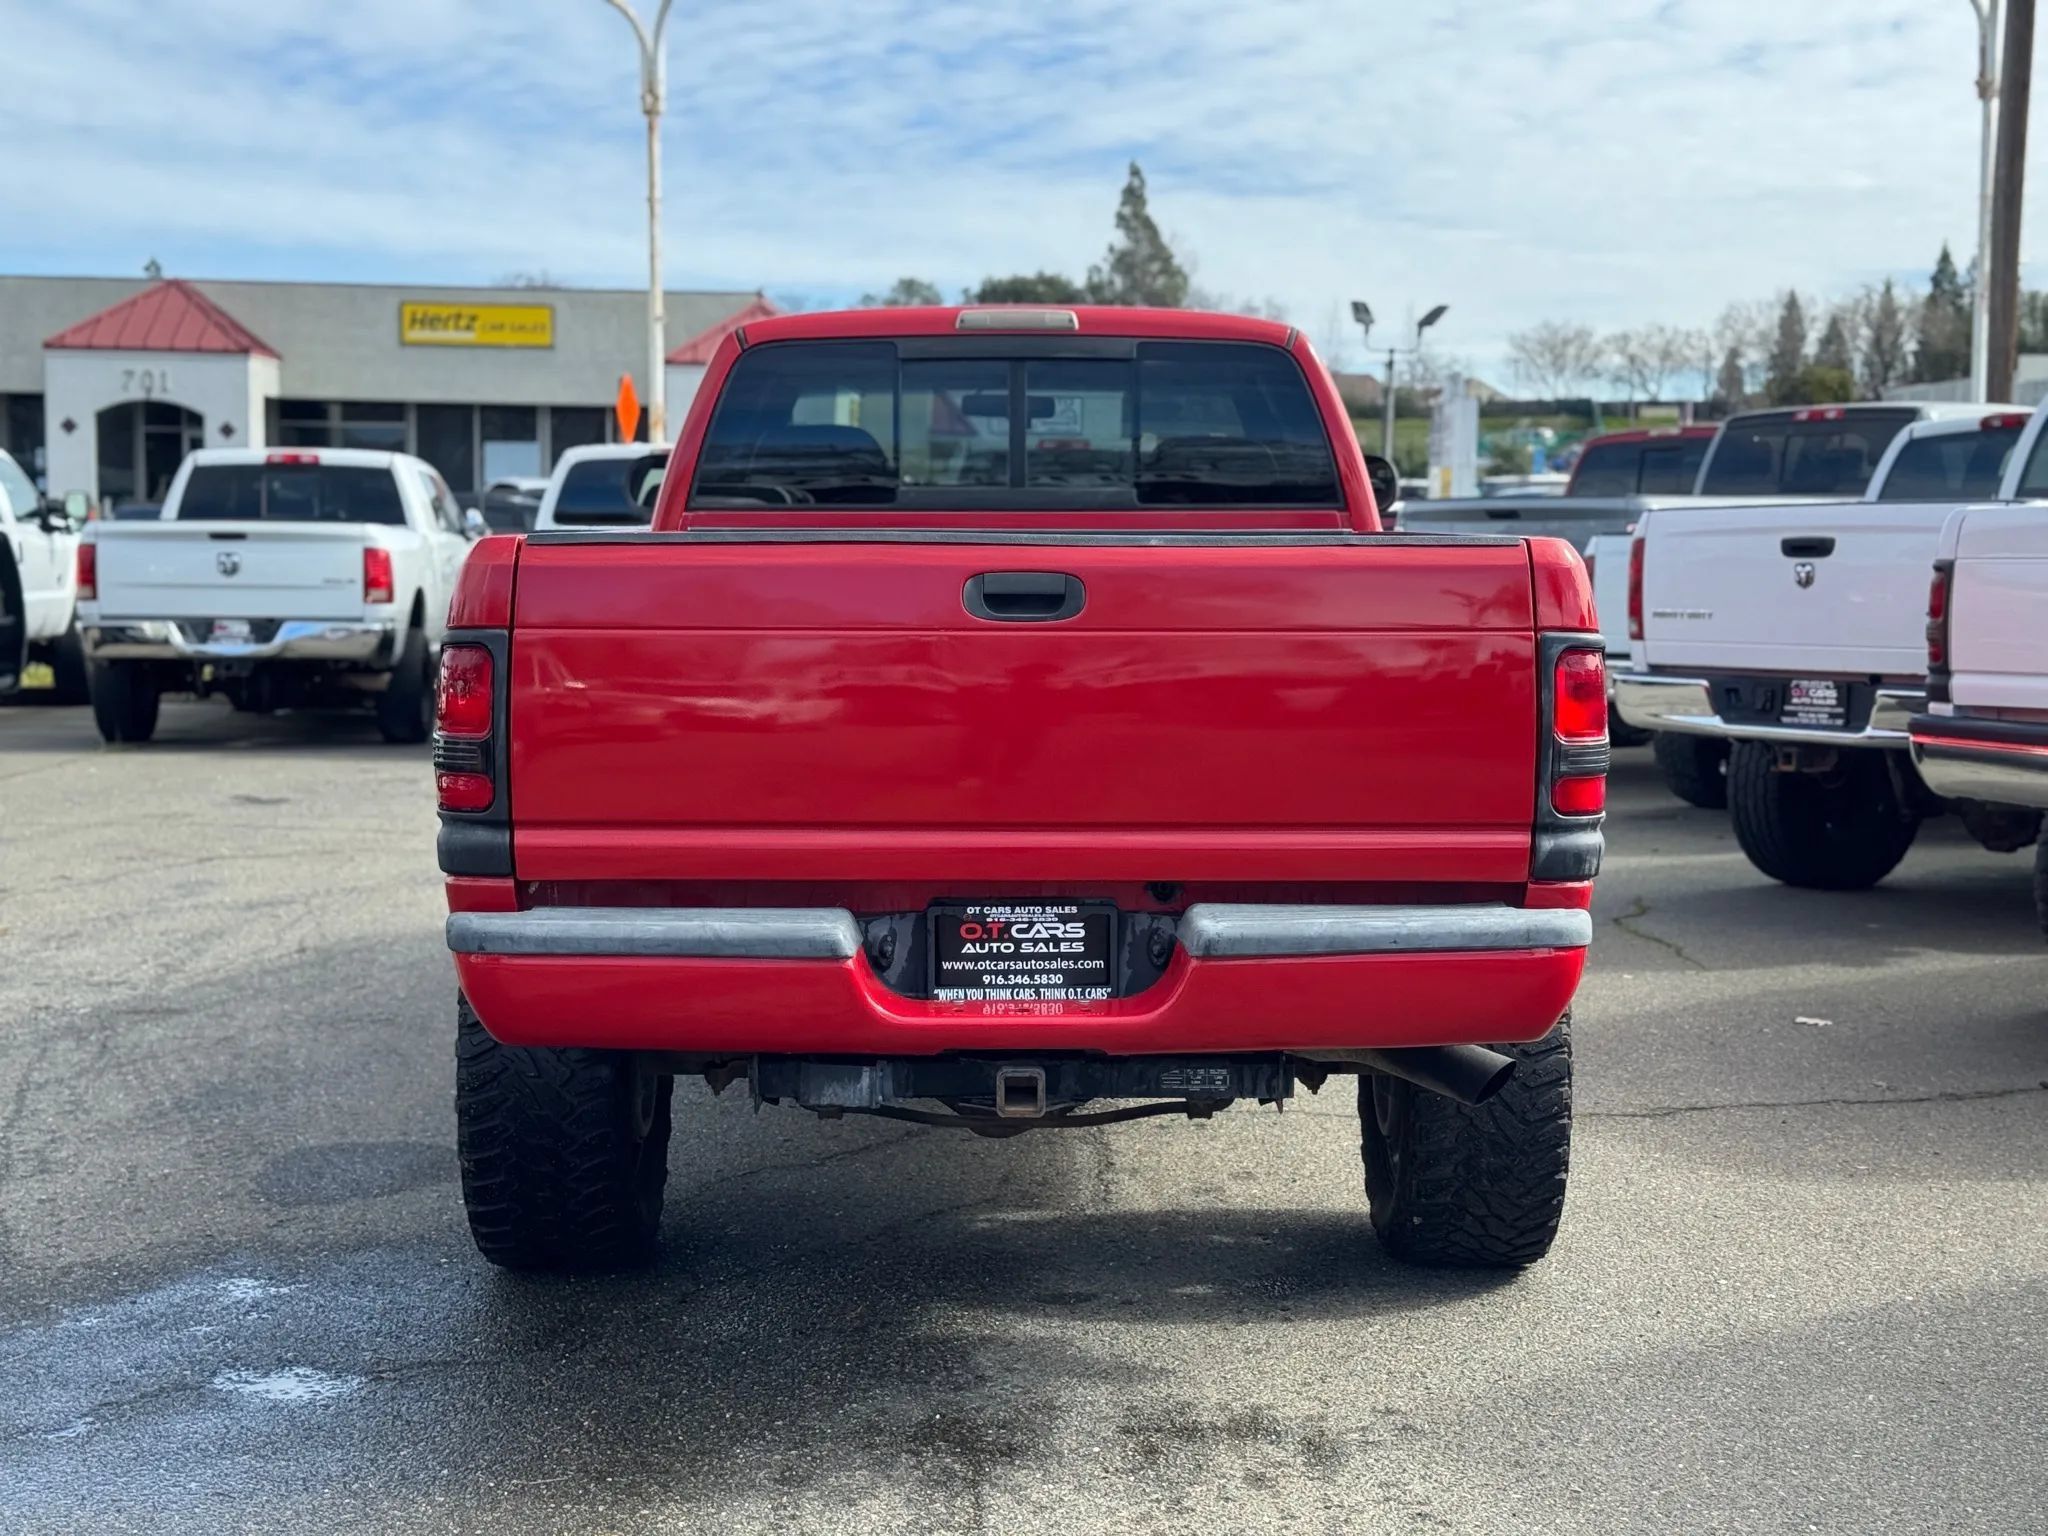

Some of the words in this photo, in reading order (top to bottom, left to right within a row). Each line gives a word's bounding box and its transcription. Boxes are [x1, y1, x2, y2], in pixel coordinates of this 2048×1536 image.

[410, 308, 478, 331] Hertz
[966, 906, 981, 914] OT
[983, 906, 1011, 914] CARS
[1014, 906, 1042, 914] AUTO
[1045, 906, 1078, 914] SALES
[961, 942, 1015, 953] AUTO
[1020, 942, 1085, 953] SALES
[942, 957, 1104, 970] www.otcarsautosales.com
[982, 974, 1063, 985] 916.346.5830
[966, 988, 983, 1000] YOU
[985, 988, 1012, 1000] THINK
[1039, 988, 1067, 1000] THINK
